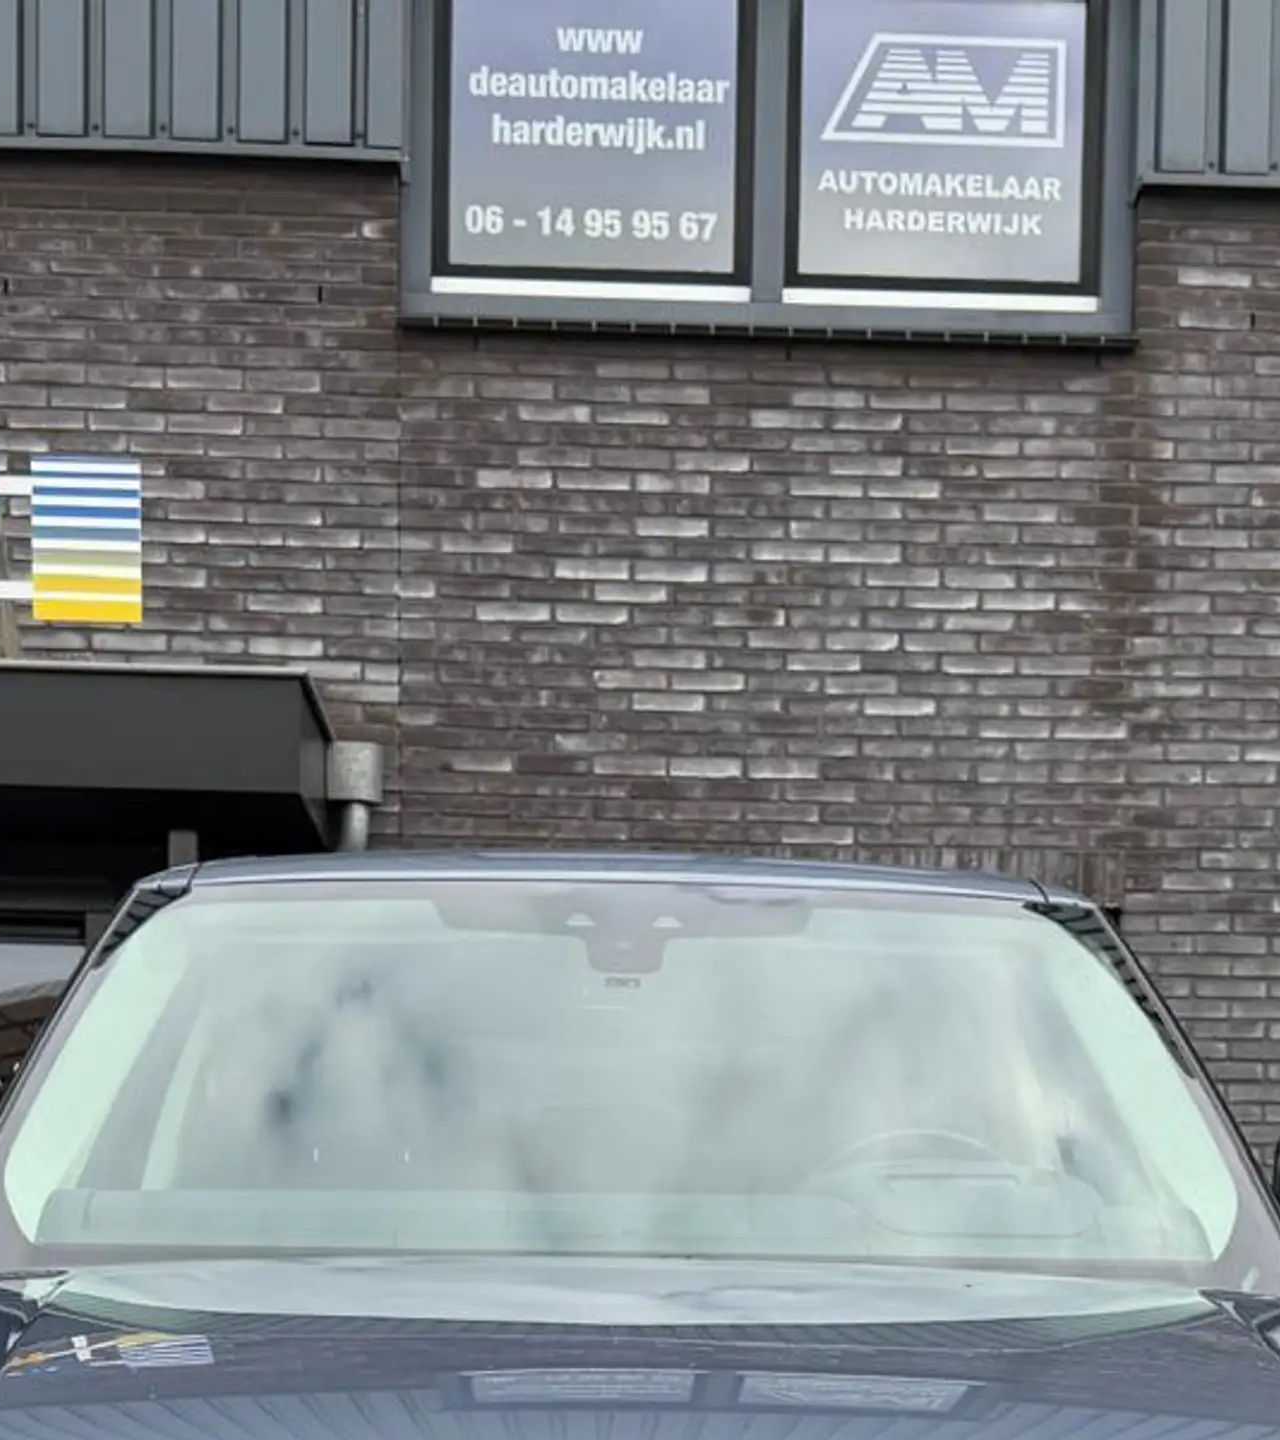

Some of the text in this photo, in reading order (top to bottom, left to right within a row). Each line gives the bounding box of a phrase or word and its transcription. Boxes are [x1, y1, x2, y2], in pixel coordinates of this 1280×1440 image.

[556, 27, 643, 54] www
[469, 65, 730, 104] deautomakelaar
[491, 112, 706, 154] harderwijk.nl
[817, 169, 1063, 201] AUTOMAKELAAR
[465, 204, 504, 235] 06
[536, 207, 576, 237] 14
[583, 208, 622, 238] 95
[631, 210, 670, 240] 95
[678, 211, 718, 242] 67
[843, 207, 1043, 236] HARDERWIJK
